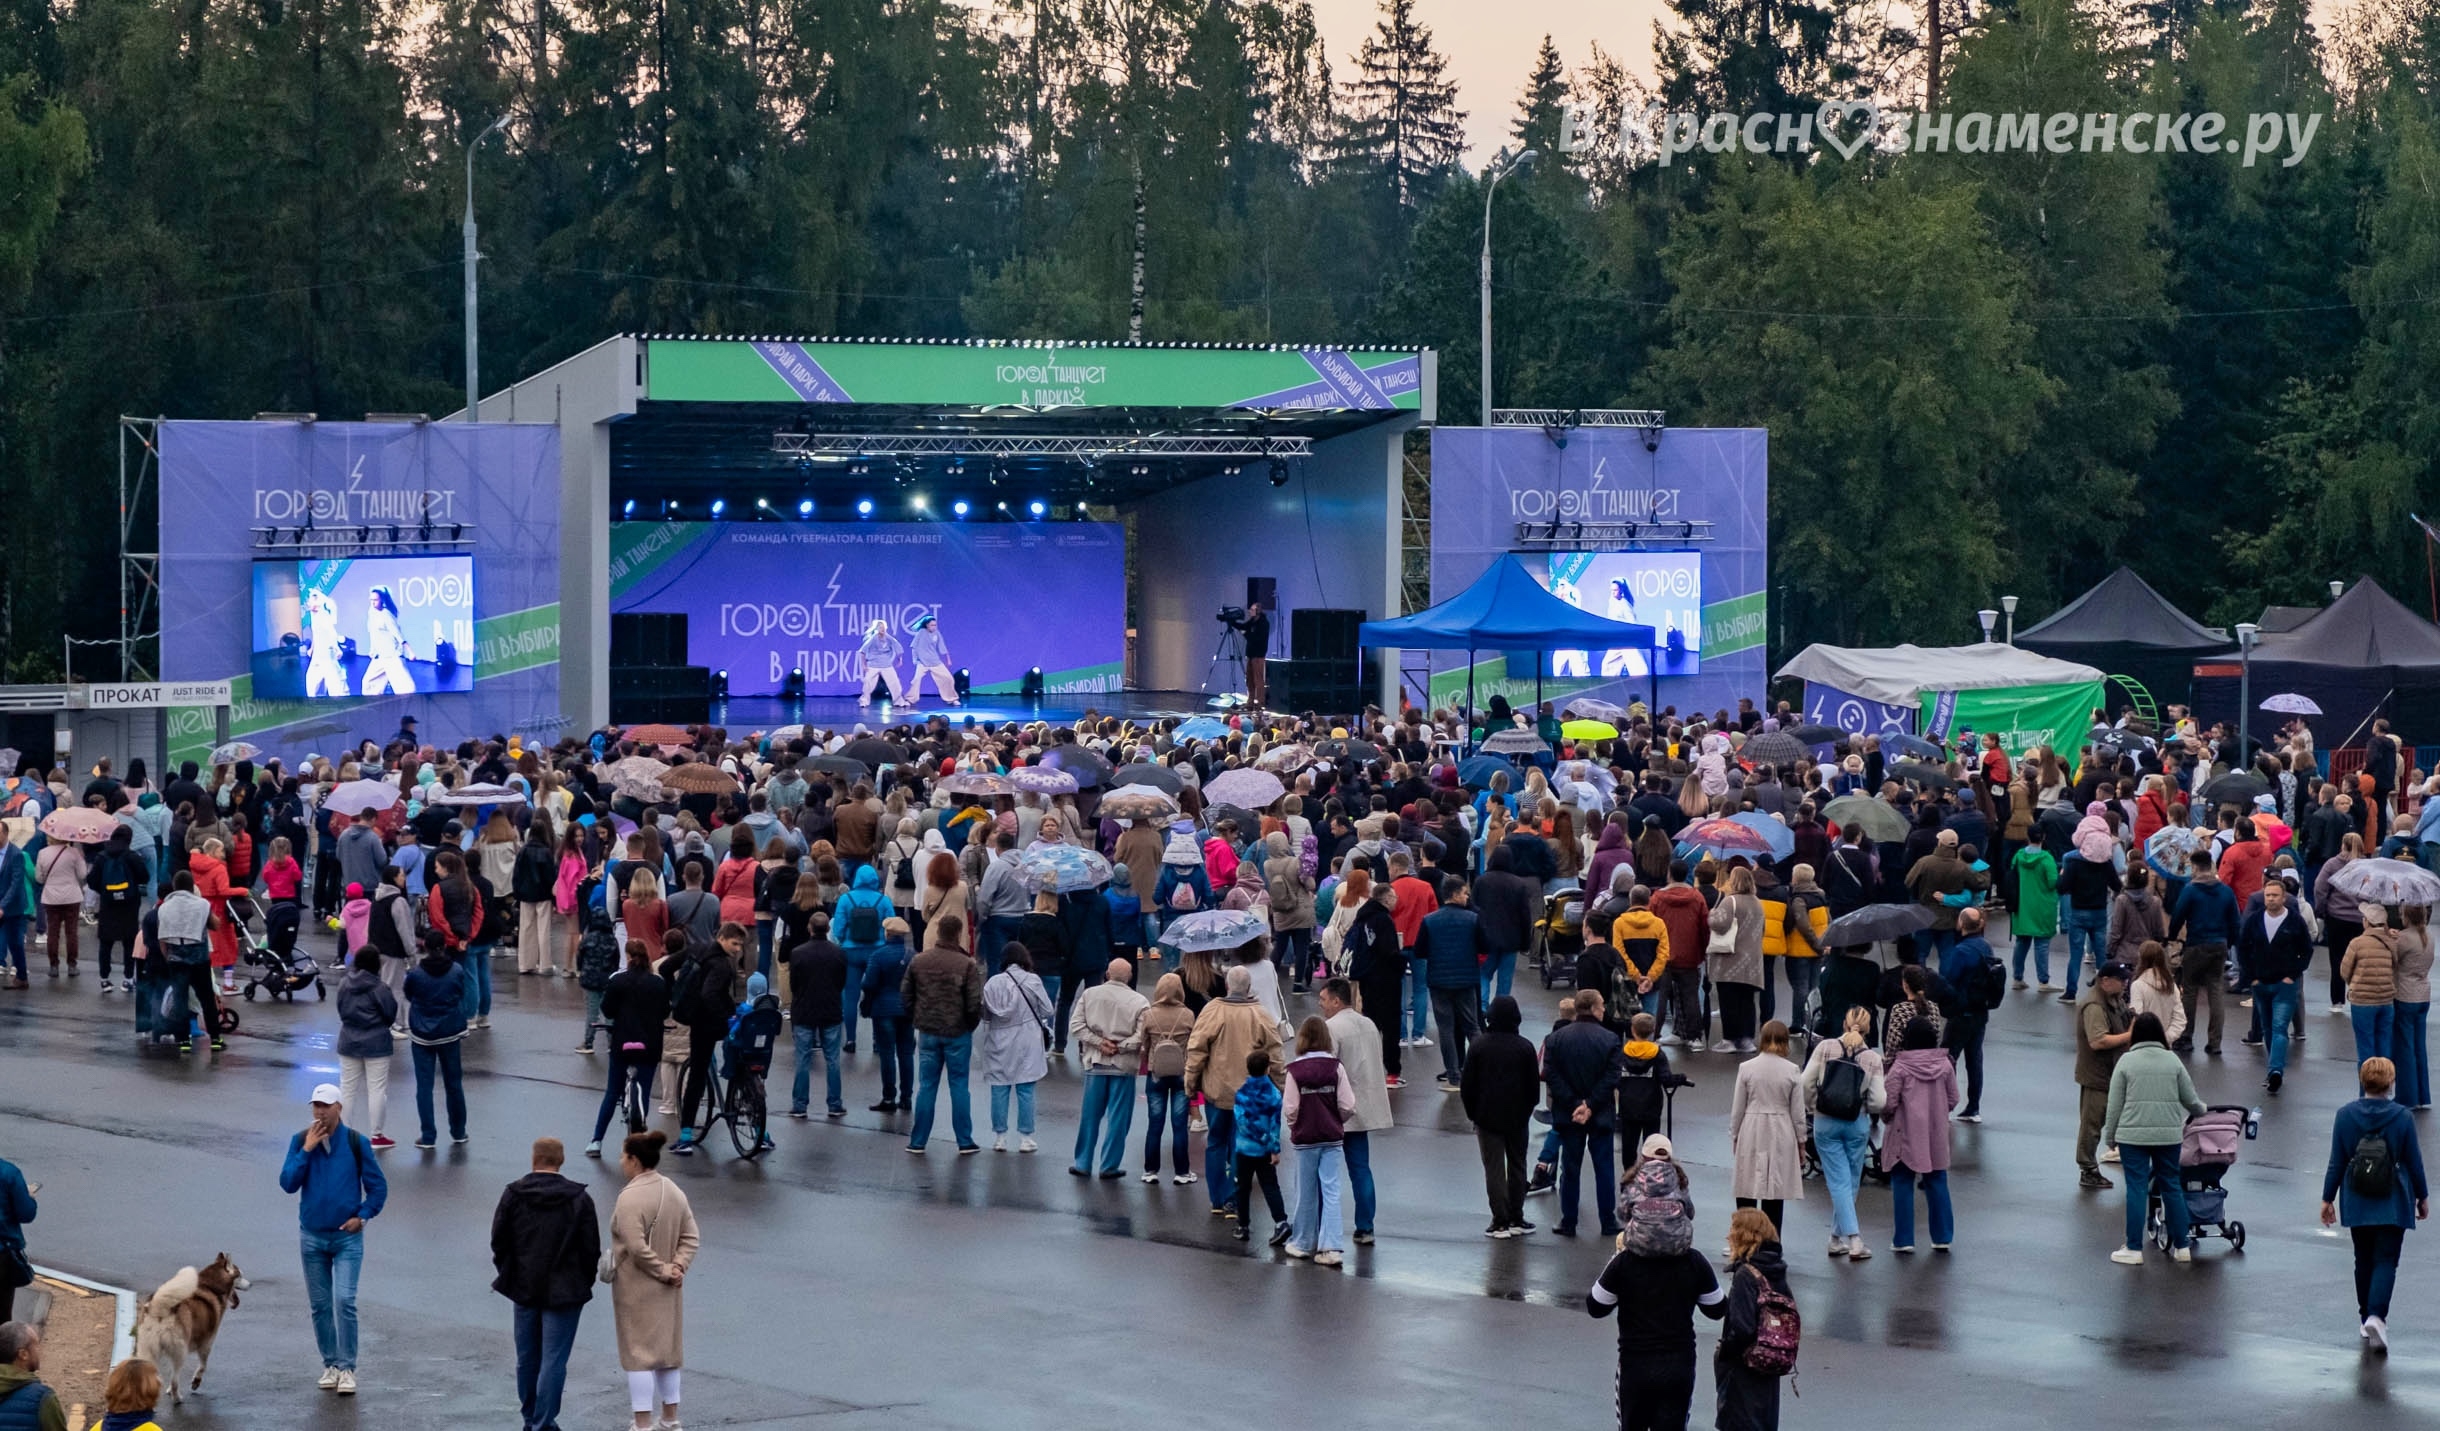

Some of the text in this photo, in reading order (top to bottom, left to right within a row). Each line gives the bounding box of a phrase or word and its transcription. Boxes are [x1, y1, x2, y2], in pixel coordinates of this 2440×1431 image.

[997, 365, 1048, 384] ГОРОД
[255, 489, 348, 521] ГОРОД
[1512, 489, 1592, 518] ГОРОД
[731, 534, 943, 545] КОМАНДА ГУБЕРНАТОРА ПРЕДСТАВЛЯЕТ
[721, 603, 824, 639] ГОРОД
[769, 651, 784, 683] В
[94, 687, 161, 703] ПРОКАТ
[173, 686, 227, 696] JUST RIDE 41
